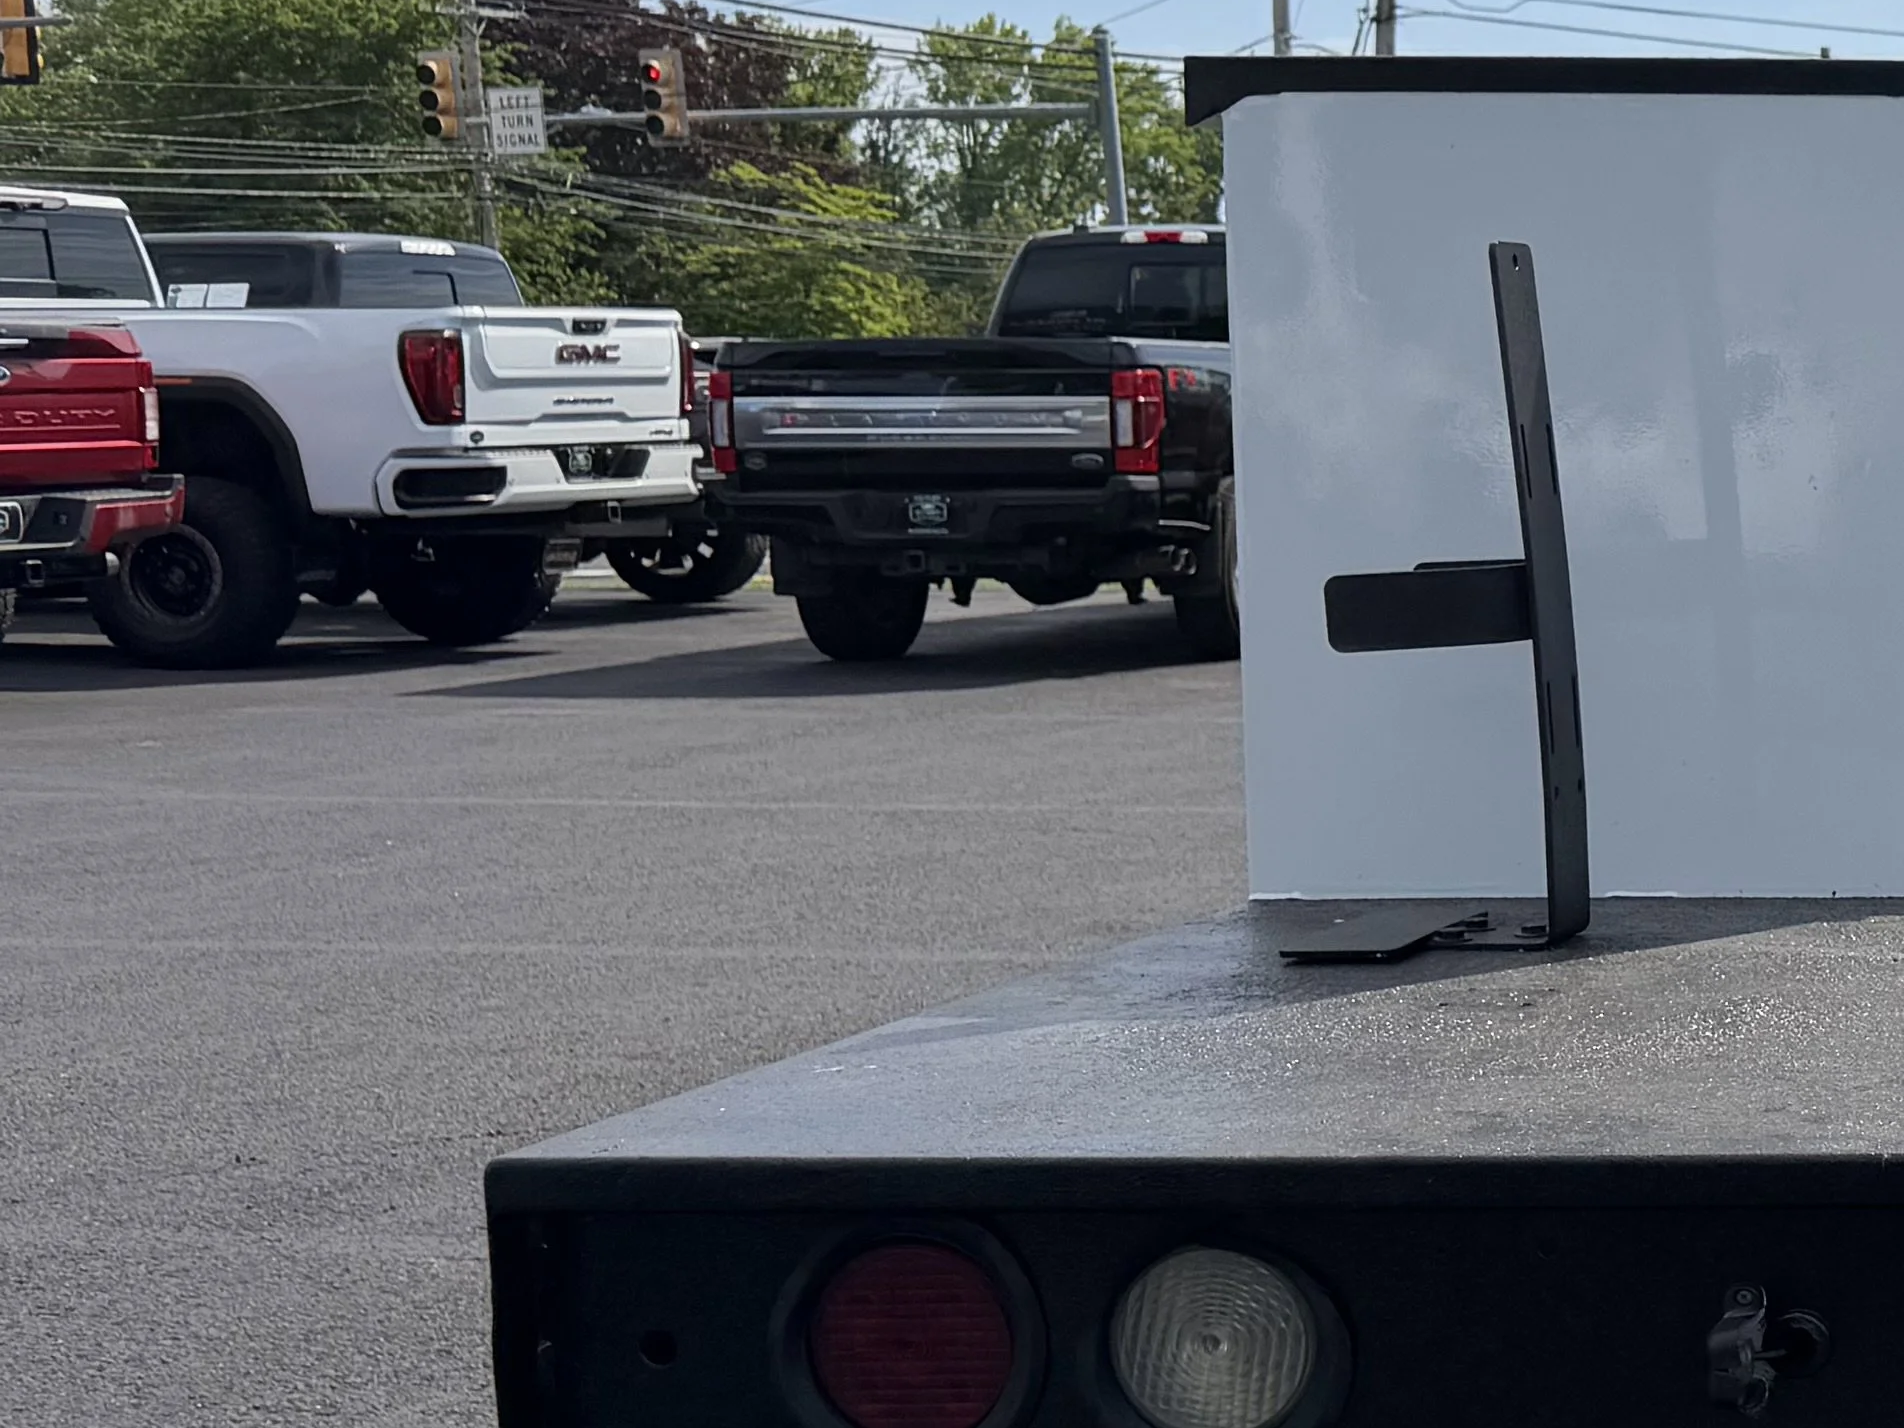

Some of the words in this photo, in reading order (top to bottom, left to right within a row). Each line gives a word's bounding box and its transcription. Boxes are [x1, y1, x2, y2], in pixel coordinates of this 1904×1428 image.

[499, 95, 530, 109] LEFT
[501, 115, 533, 129] TURN
[496, 132, 540, 148] SIGNAL
[555, 343, 621, 365] GMC
